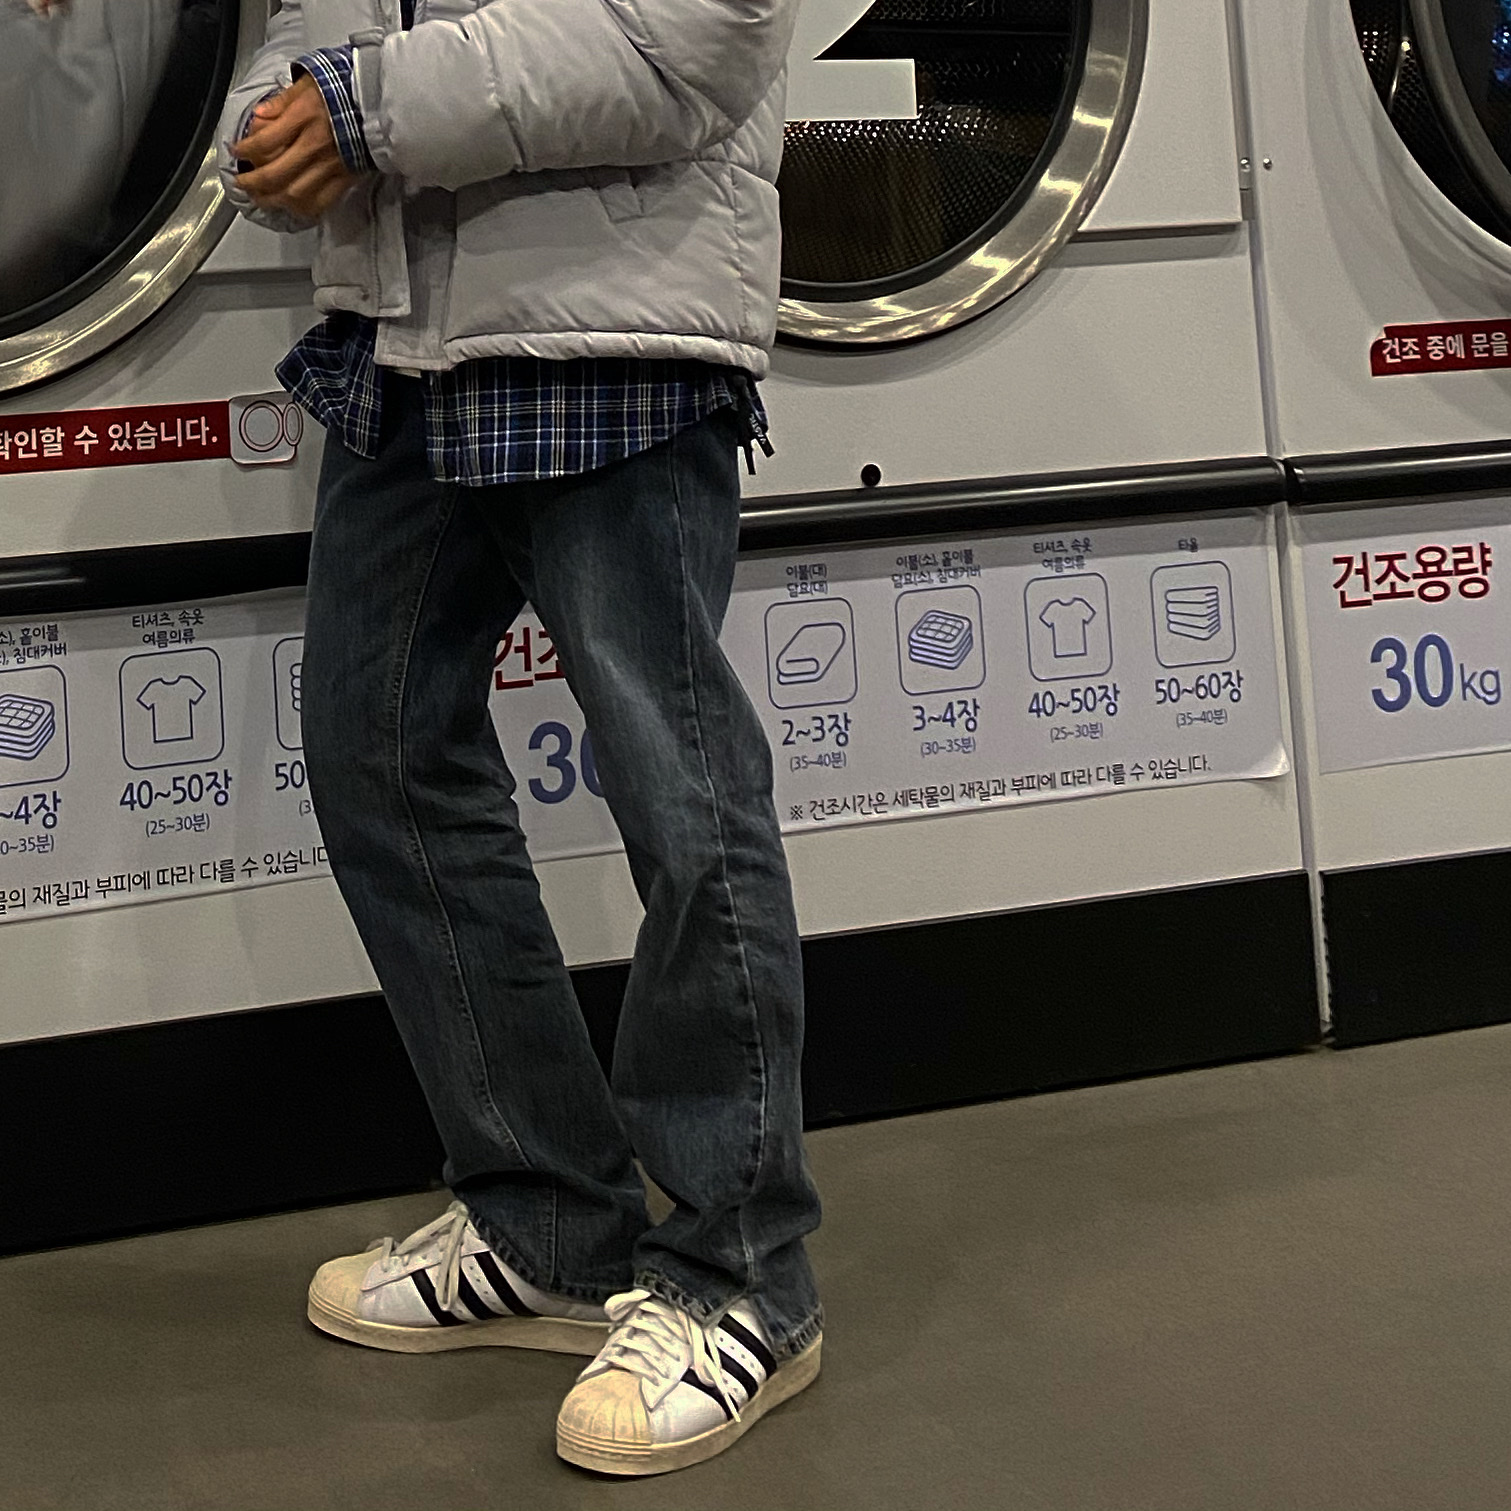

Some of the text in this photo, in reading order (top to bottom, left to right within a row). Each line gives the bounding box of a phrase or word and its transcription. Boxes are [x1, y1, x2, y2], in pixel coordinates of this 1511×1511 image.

[1382, 331, 1509, 364] 건조 중에 문을
[73, 425, 99, 456] 수
[108, 415, 219, 452] 있습니다.
[1332, 541, 1493, 609] 건조용량
[178, 608, 205, 628] 속옷
[13, 642, 68, 665] 침대커버
[142, 627, 196, 647] 여름의류
[1028, 682, 1121, 719] 40~50장
[1154, 669, 1244, 706] 50~60장
[781, 713, 853, 748] 2~3장
[912, 698, 981, 733] 3~4장
[119, 768, 233, 812] 40~50장
[809, 754, 1212, 822] 건조시간은 세탁물의 재질과 부피에 따라 다를 있습니다.
[145, 812, 211, 838] (25~30분)
[32, 882, 90, 911] 재질과
[94, 873, 151, 900] 부피에
[156, 864, 195, 887] 따라
[200, 858, 236, 884] 다를
